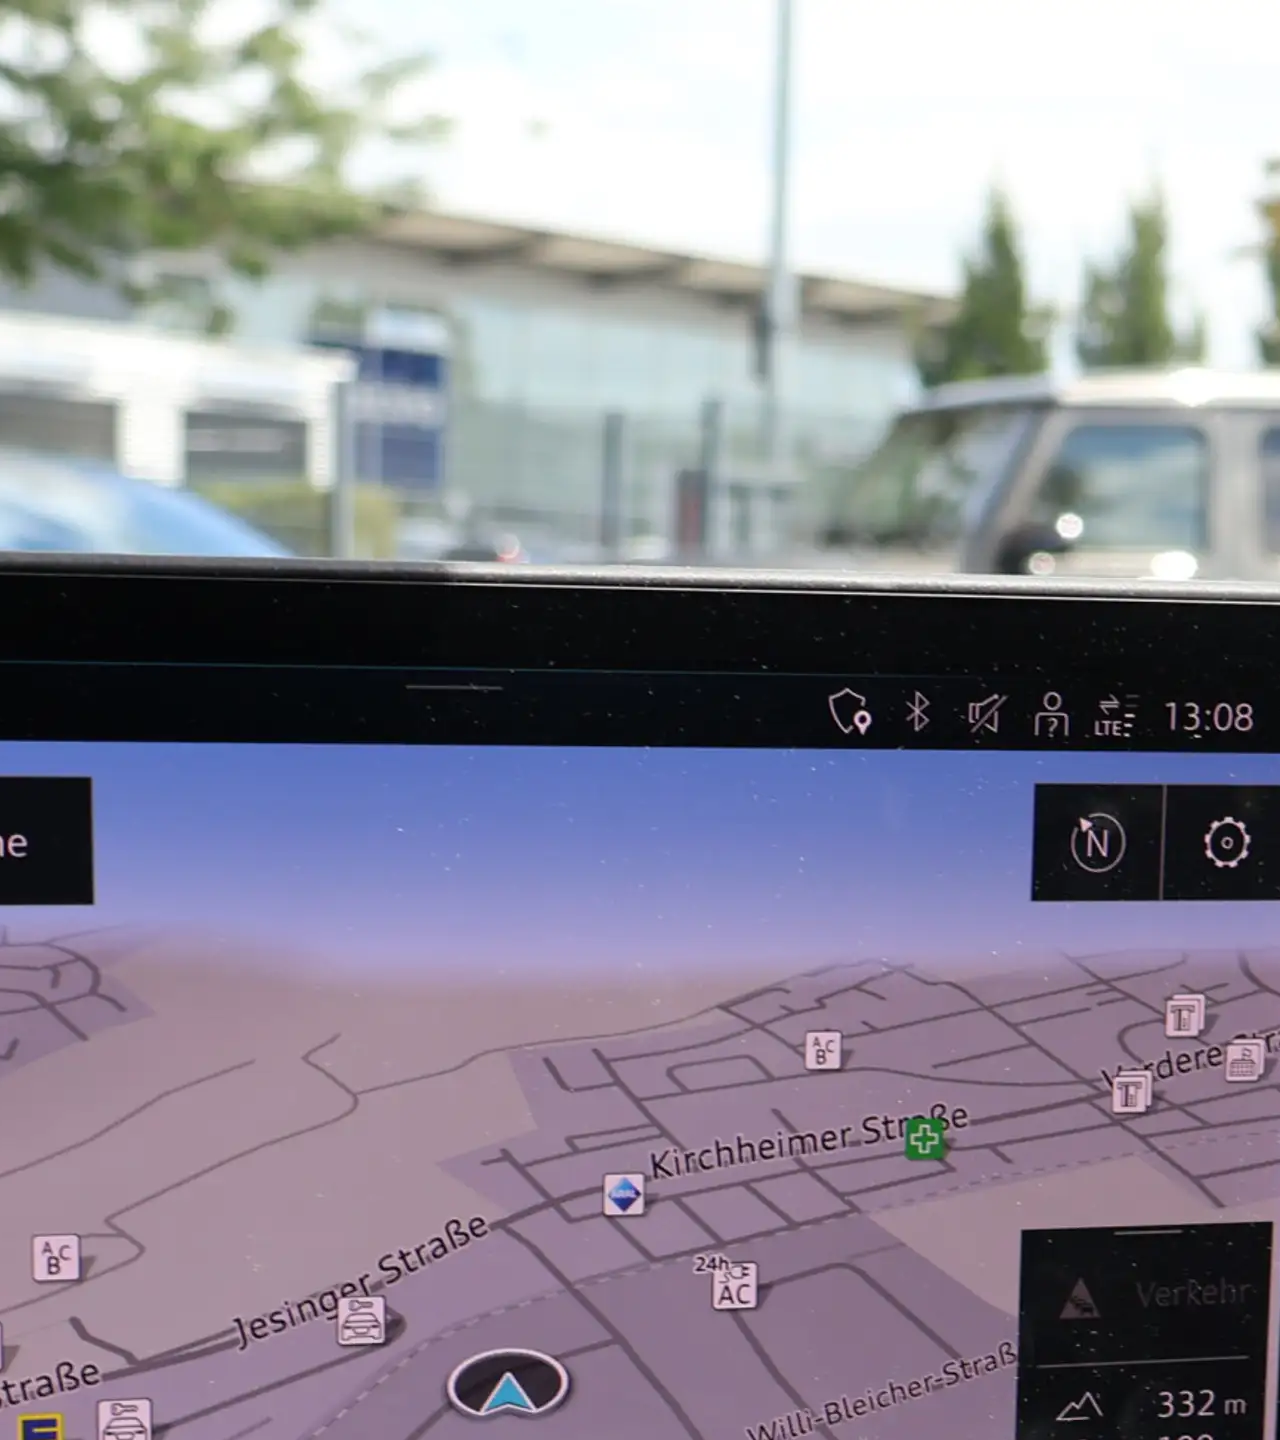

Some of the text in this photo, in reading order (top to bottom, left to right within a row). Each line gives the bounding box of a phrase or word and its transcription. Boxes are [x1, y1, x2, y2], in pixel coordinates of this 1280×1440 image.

[1094, 720, 1123, 737] LTE
[1164, 702, 1255, 732] 13:08
[1085, 829, 1110, 858] N
[649, 1102, 969, 1180] Kirchheimer Strße
[695, 1256, 730, 1272] 24h
[232, 1216, 489, 1351] Jesinger Straße
[718, 1284, 751, 1306] AC
[1134, 1276, 1252, 1308] Verkehr
[1157, 1389, 1248, 1418] 332 m
